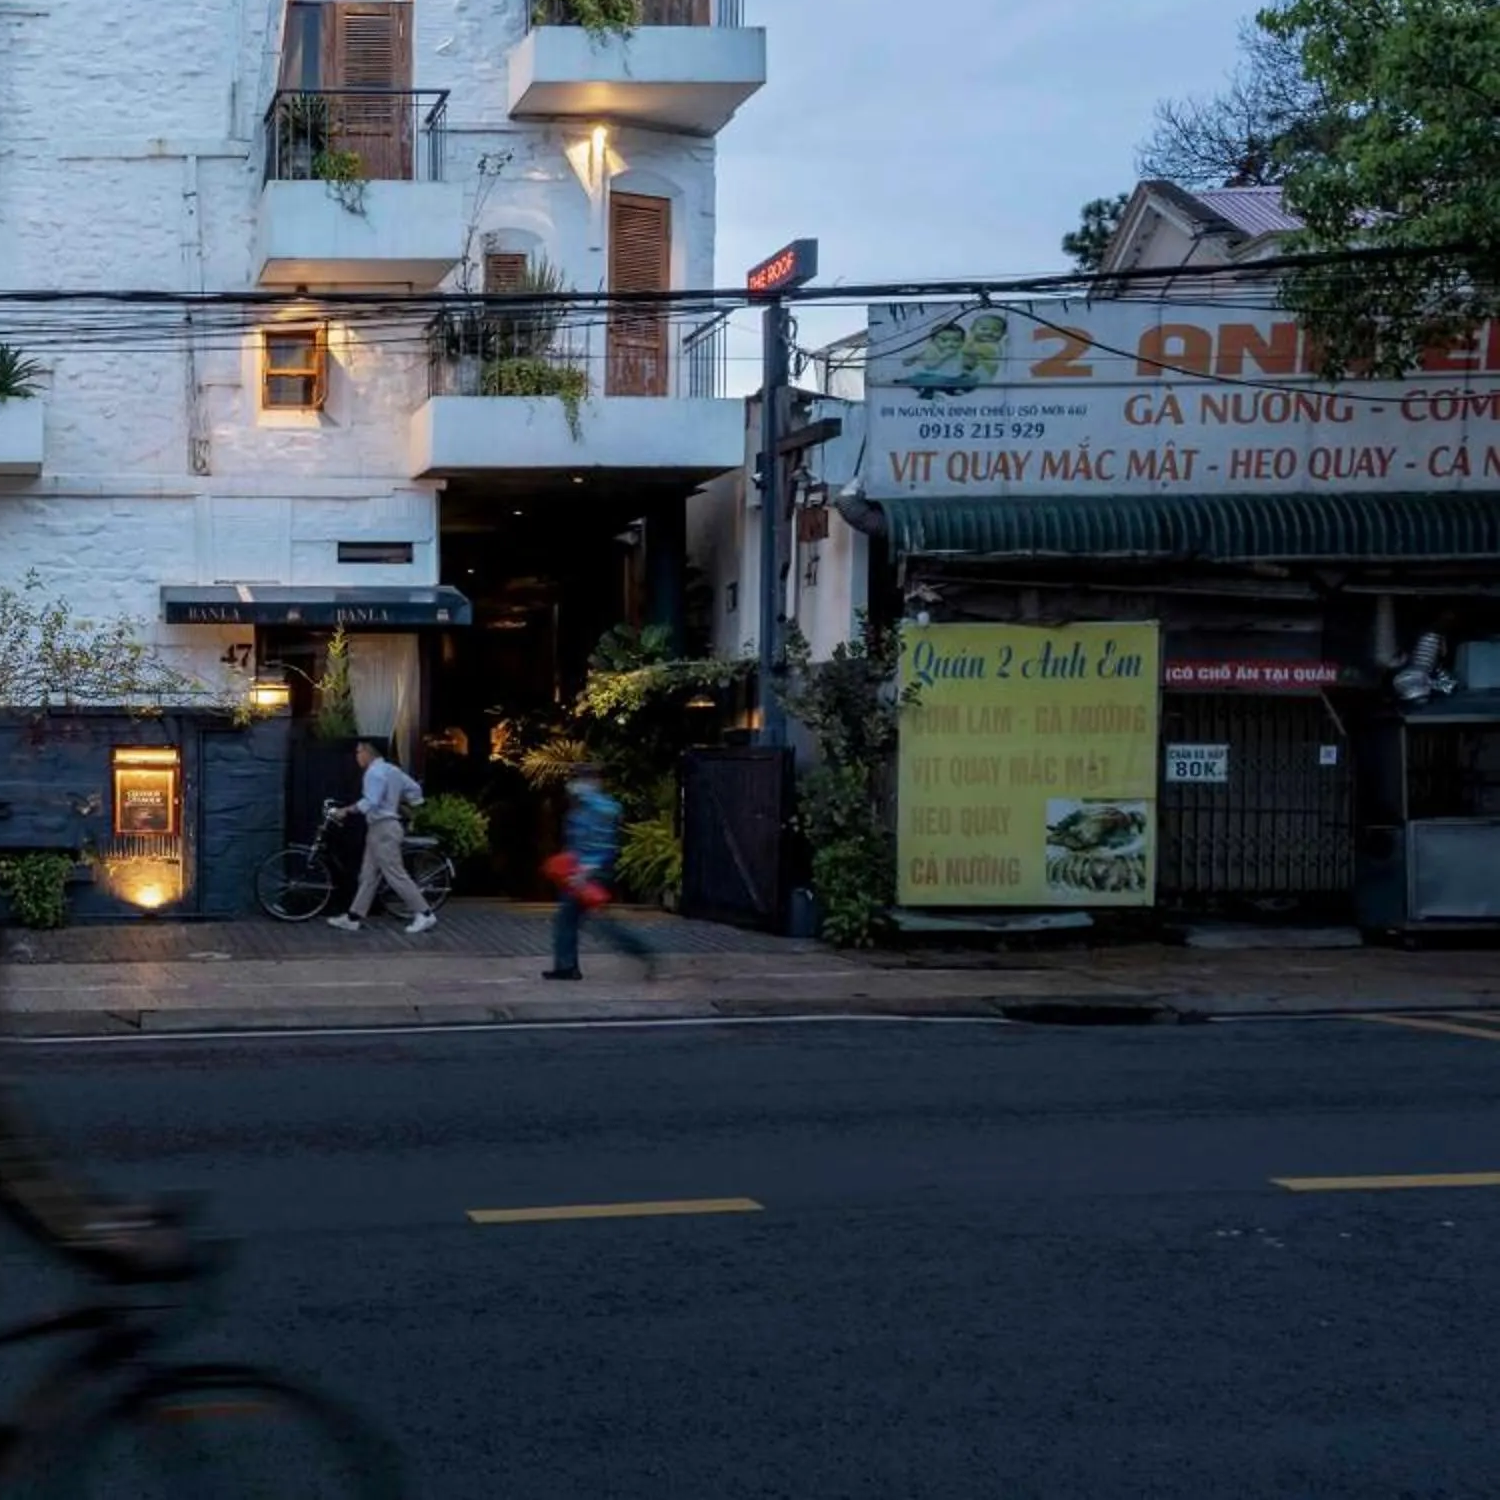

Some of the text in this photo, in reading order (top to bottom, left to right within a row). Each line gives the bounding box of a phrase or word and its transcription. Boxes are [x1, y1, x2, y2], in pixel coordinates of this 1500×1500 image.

[1029, 325, 1093, 378] 2
[1137, 321, 1376, 377] AN
[1123, 384, 1184, 425] GÀ
[919, 422, 1045, 439] 0918 215 929
[889, 450, 938, 490] VỊT
[946, 450, 1033, 484] QUAY
[1040, 436, 1116, 482] MẮC
[1126, 440, 1199, 488] MẬT
[1229, 447, 1297, 481] HEO
[1308, 445, 1398, 481] QUAY
[1428, 435, 1471, 477] CÁ
[913, 638, 1142, 687] Quán 2 Anh Em
[949, 755, 1001, 788] QUAY
[911, 805, 1012, 837] HEO QUAY
